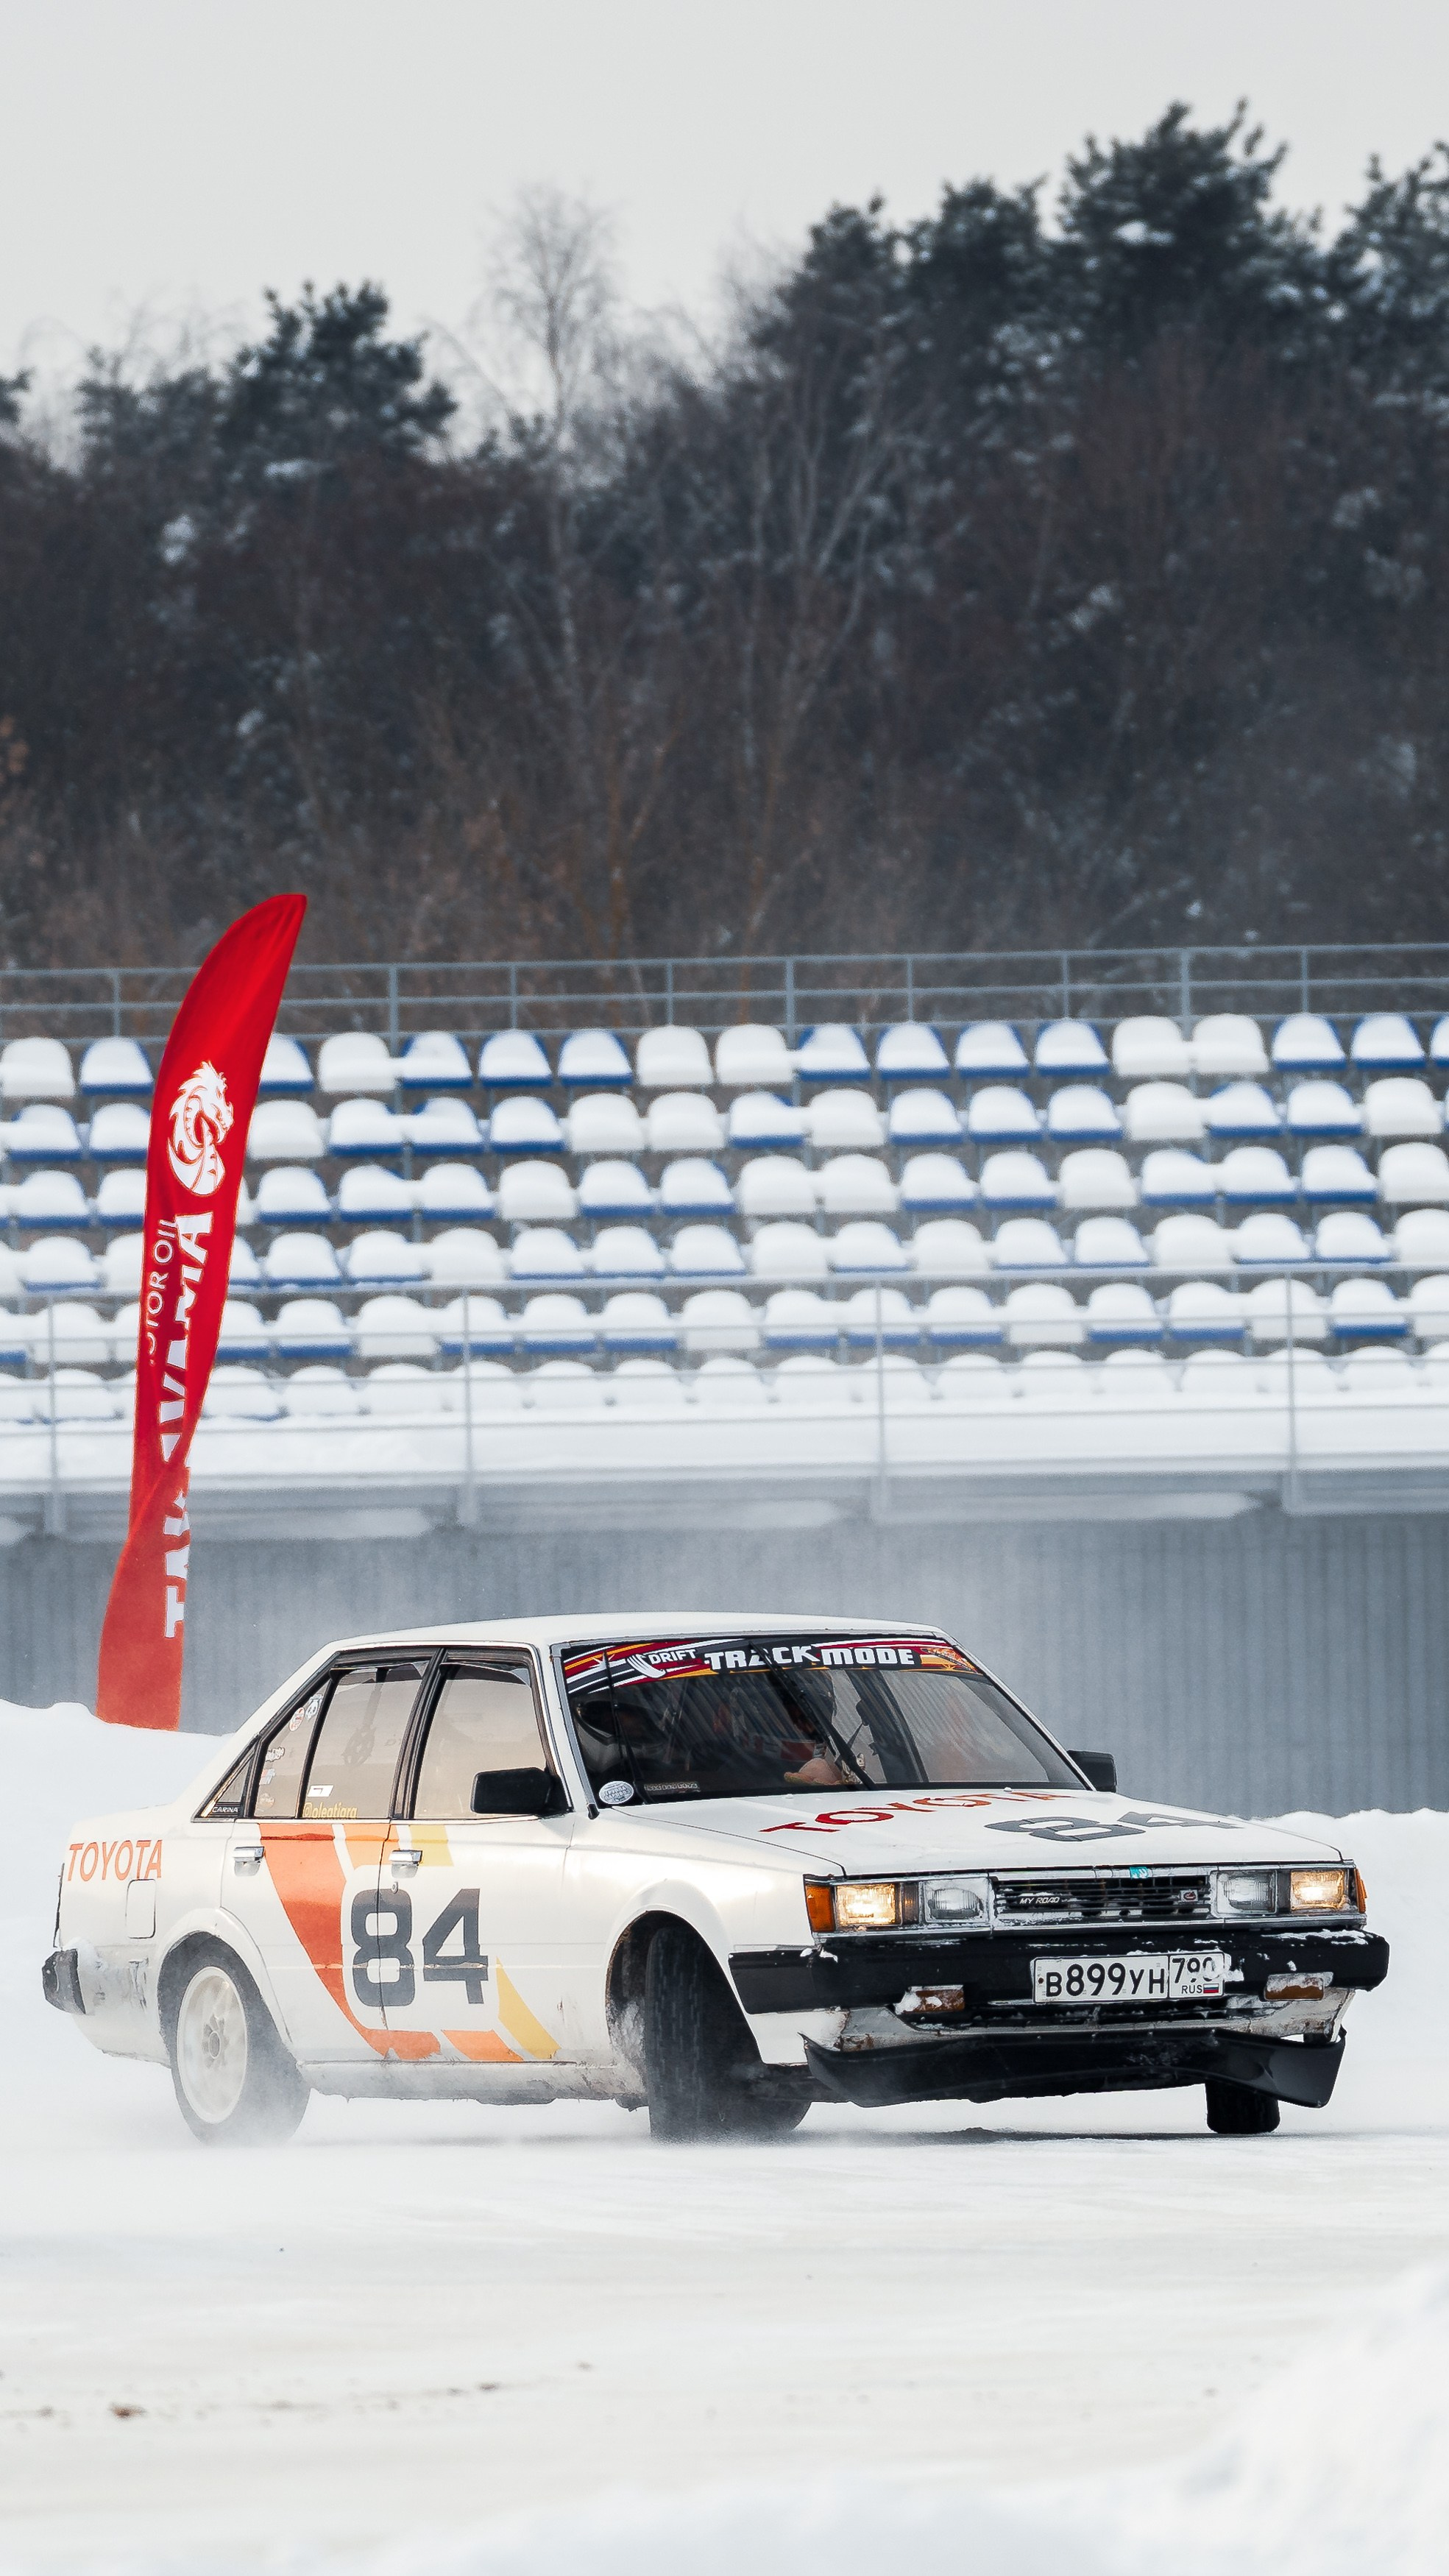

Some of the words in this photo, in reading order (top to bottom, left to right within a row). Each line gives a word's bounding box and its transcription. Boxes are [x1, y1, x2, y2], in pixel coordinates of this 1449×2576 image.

[153, 1218, 177, 1264] OIL
[146, 1271, 170, 1365] OOR
[648, 1649, 696, 1665] DRIFT
[820, 1647, 914, 1666] MODE
[759, 1791, 1079, 1833] TOYOTA
[983, 1810, 1246, 1842] 84
[68, 1839, 163, 1881] TOYOTA
[1035, 1896, 1060, 1904] ROAD
[350, 1888, 489, 2007] 84
[1181, 1984, 1202, 1994] RUS
